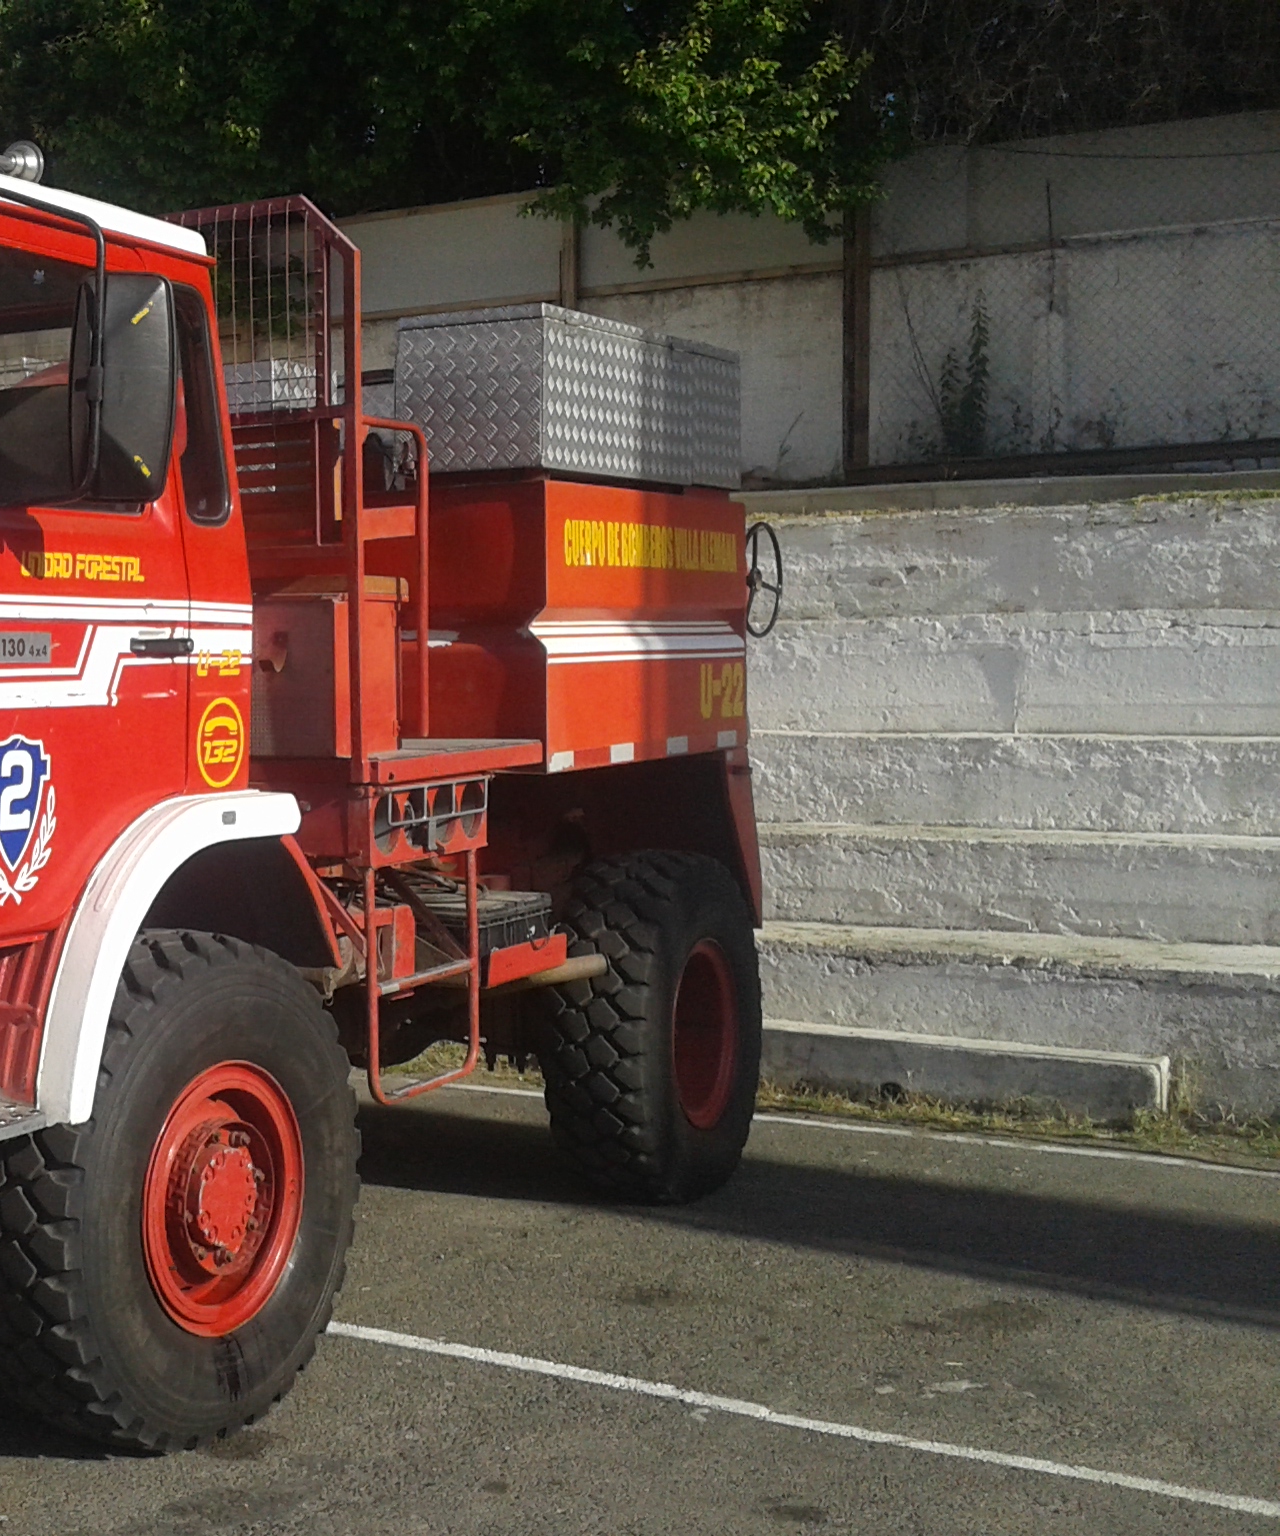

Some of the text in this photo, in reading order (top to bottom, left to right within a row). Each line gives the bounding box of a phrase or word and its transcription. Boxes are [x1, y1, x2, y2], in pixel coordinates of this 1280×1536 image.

[564, 518, 606, 567] CUERPO
[607, 521, 620, 566] DE
[75, 553, 145, 583] FORESTAL
[1, 637, 26, 658] 130
[28, 644, 48, 657] 4x4
[196, 649, 242, 677] U-22
[699, 662, 745, 720] U-22
[203, 739, 237, 764] 132
[0, 749, 33, 831] 2
